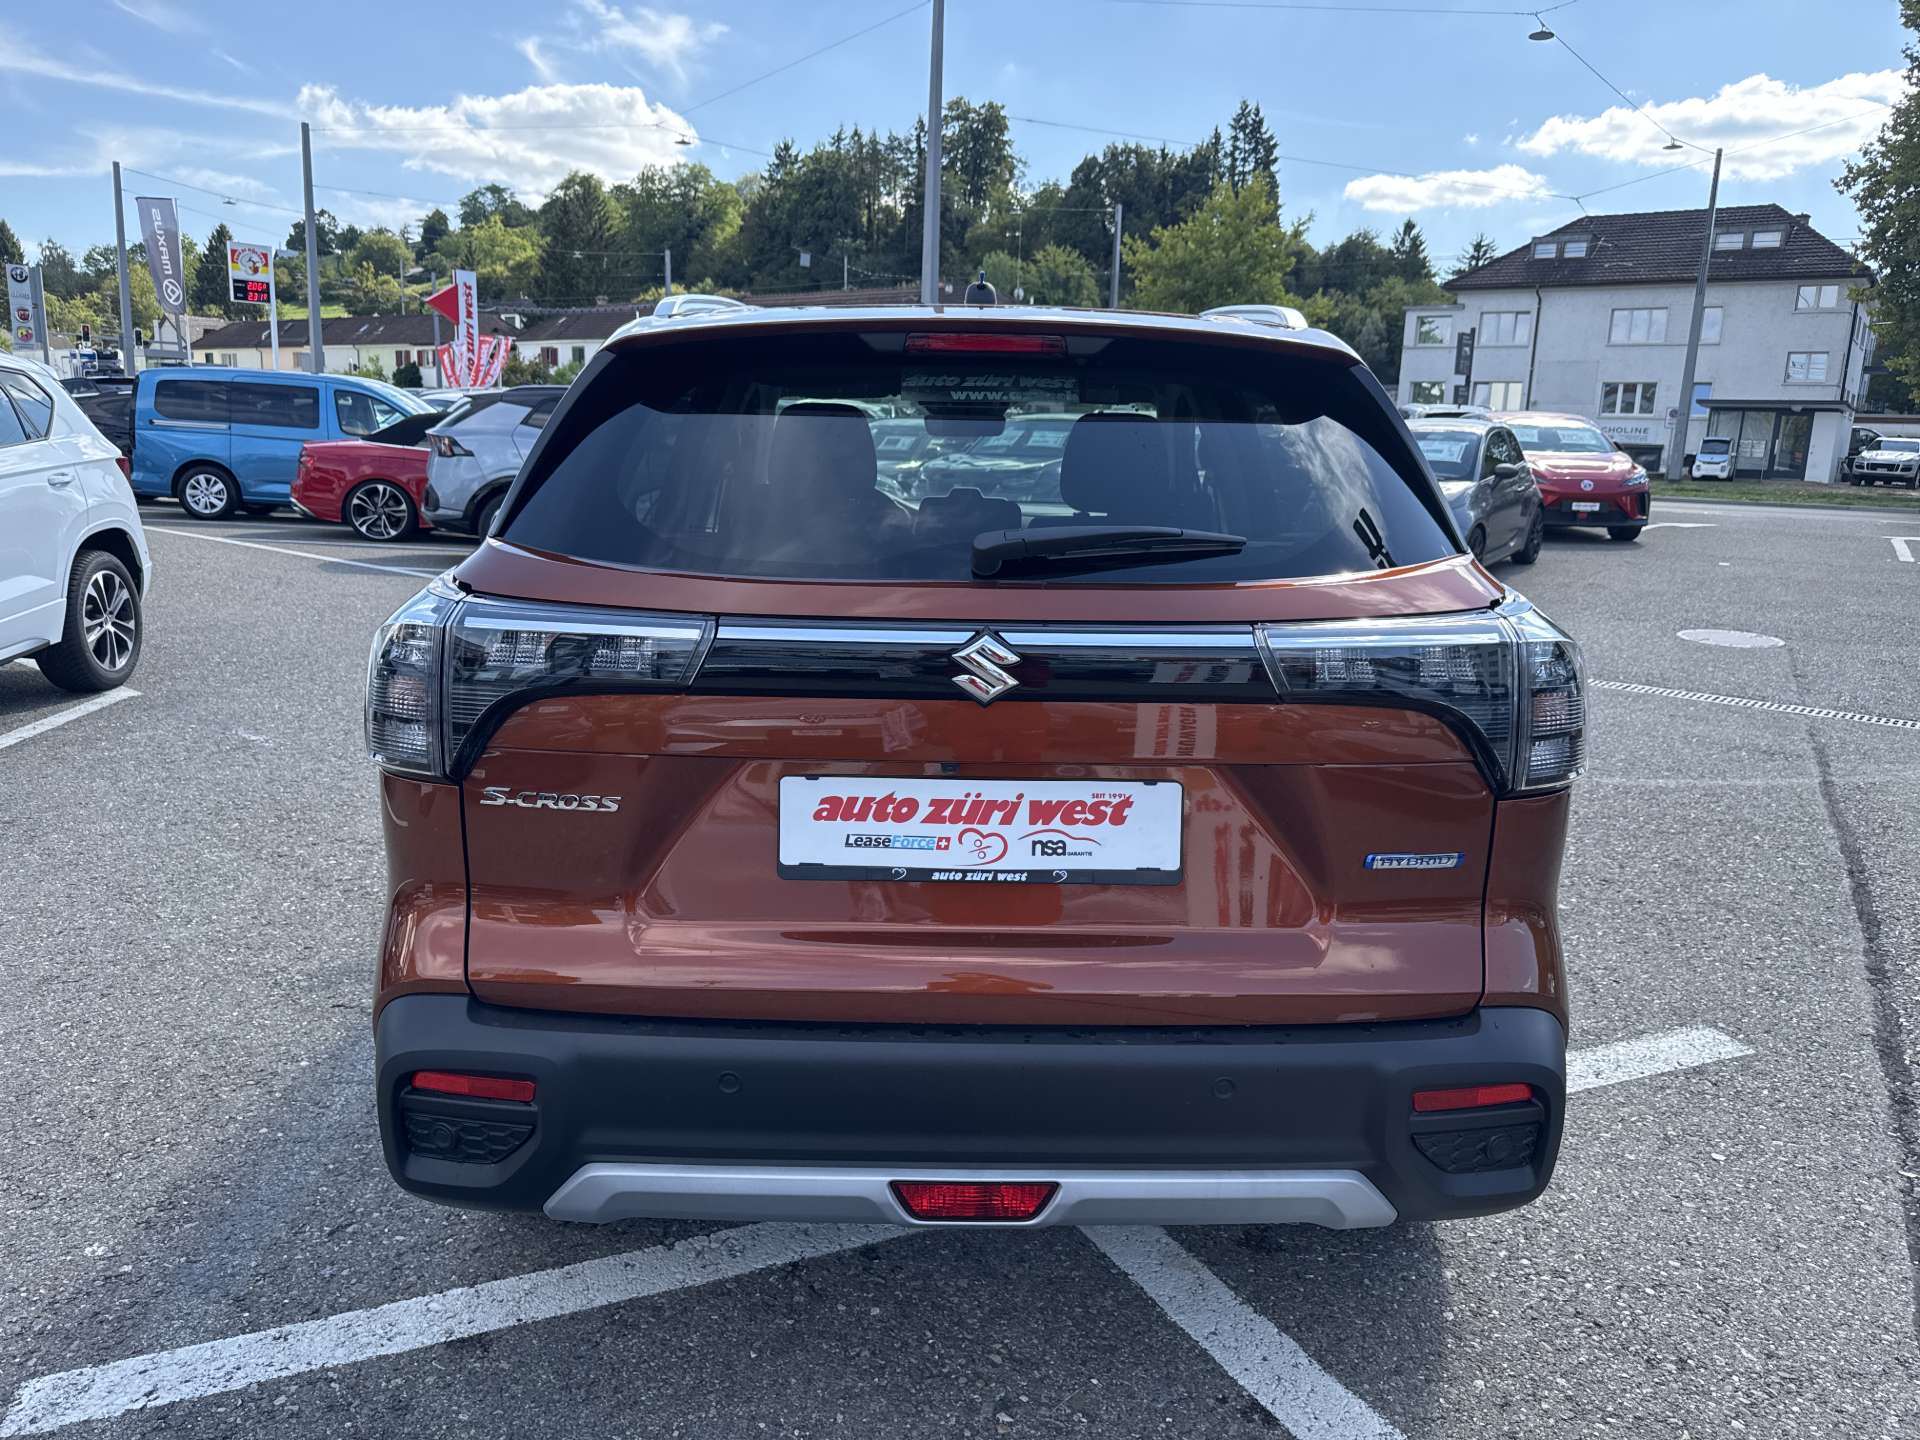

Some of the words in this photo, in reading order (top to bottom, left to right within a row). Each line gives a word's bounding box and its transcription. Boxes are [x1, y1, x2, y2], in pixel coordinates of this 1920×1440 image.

[480, 786, 622, 813] S-CROSS
[812, 790, 920, 824] auto
[920, 792, 1025, 826] züri
[1028, 794, 1135, 826] west
[844, 833, 936, 849] LeaseForce
[1031, 839, 1067, 857] nsa
[931, 871, 963, 881] auto
[965, 870, 995, 881] züri
[997, 871, 1028, 882] west
